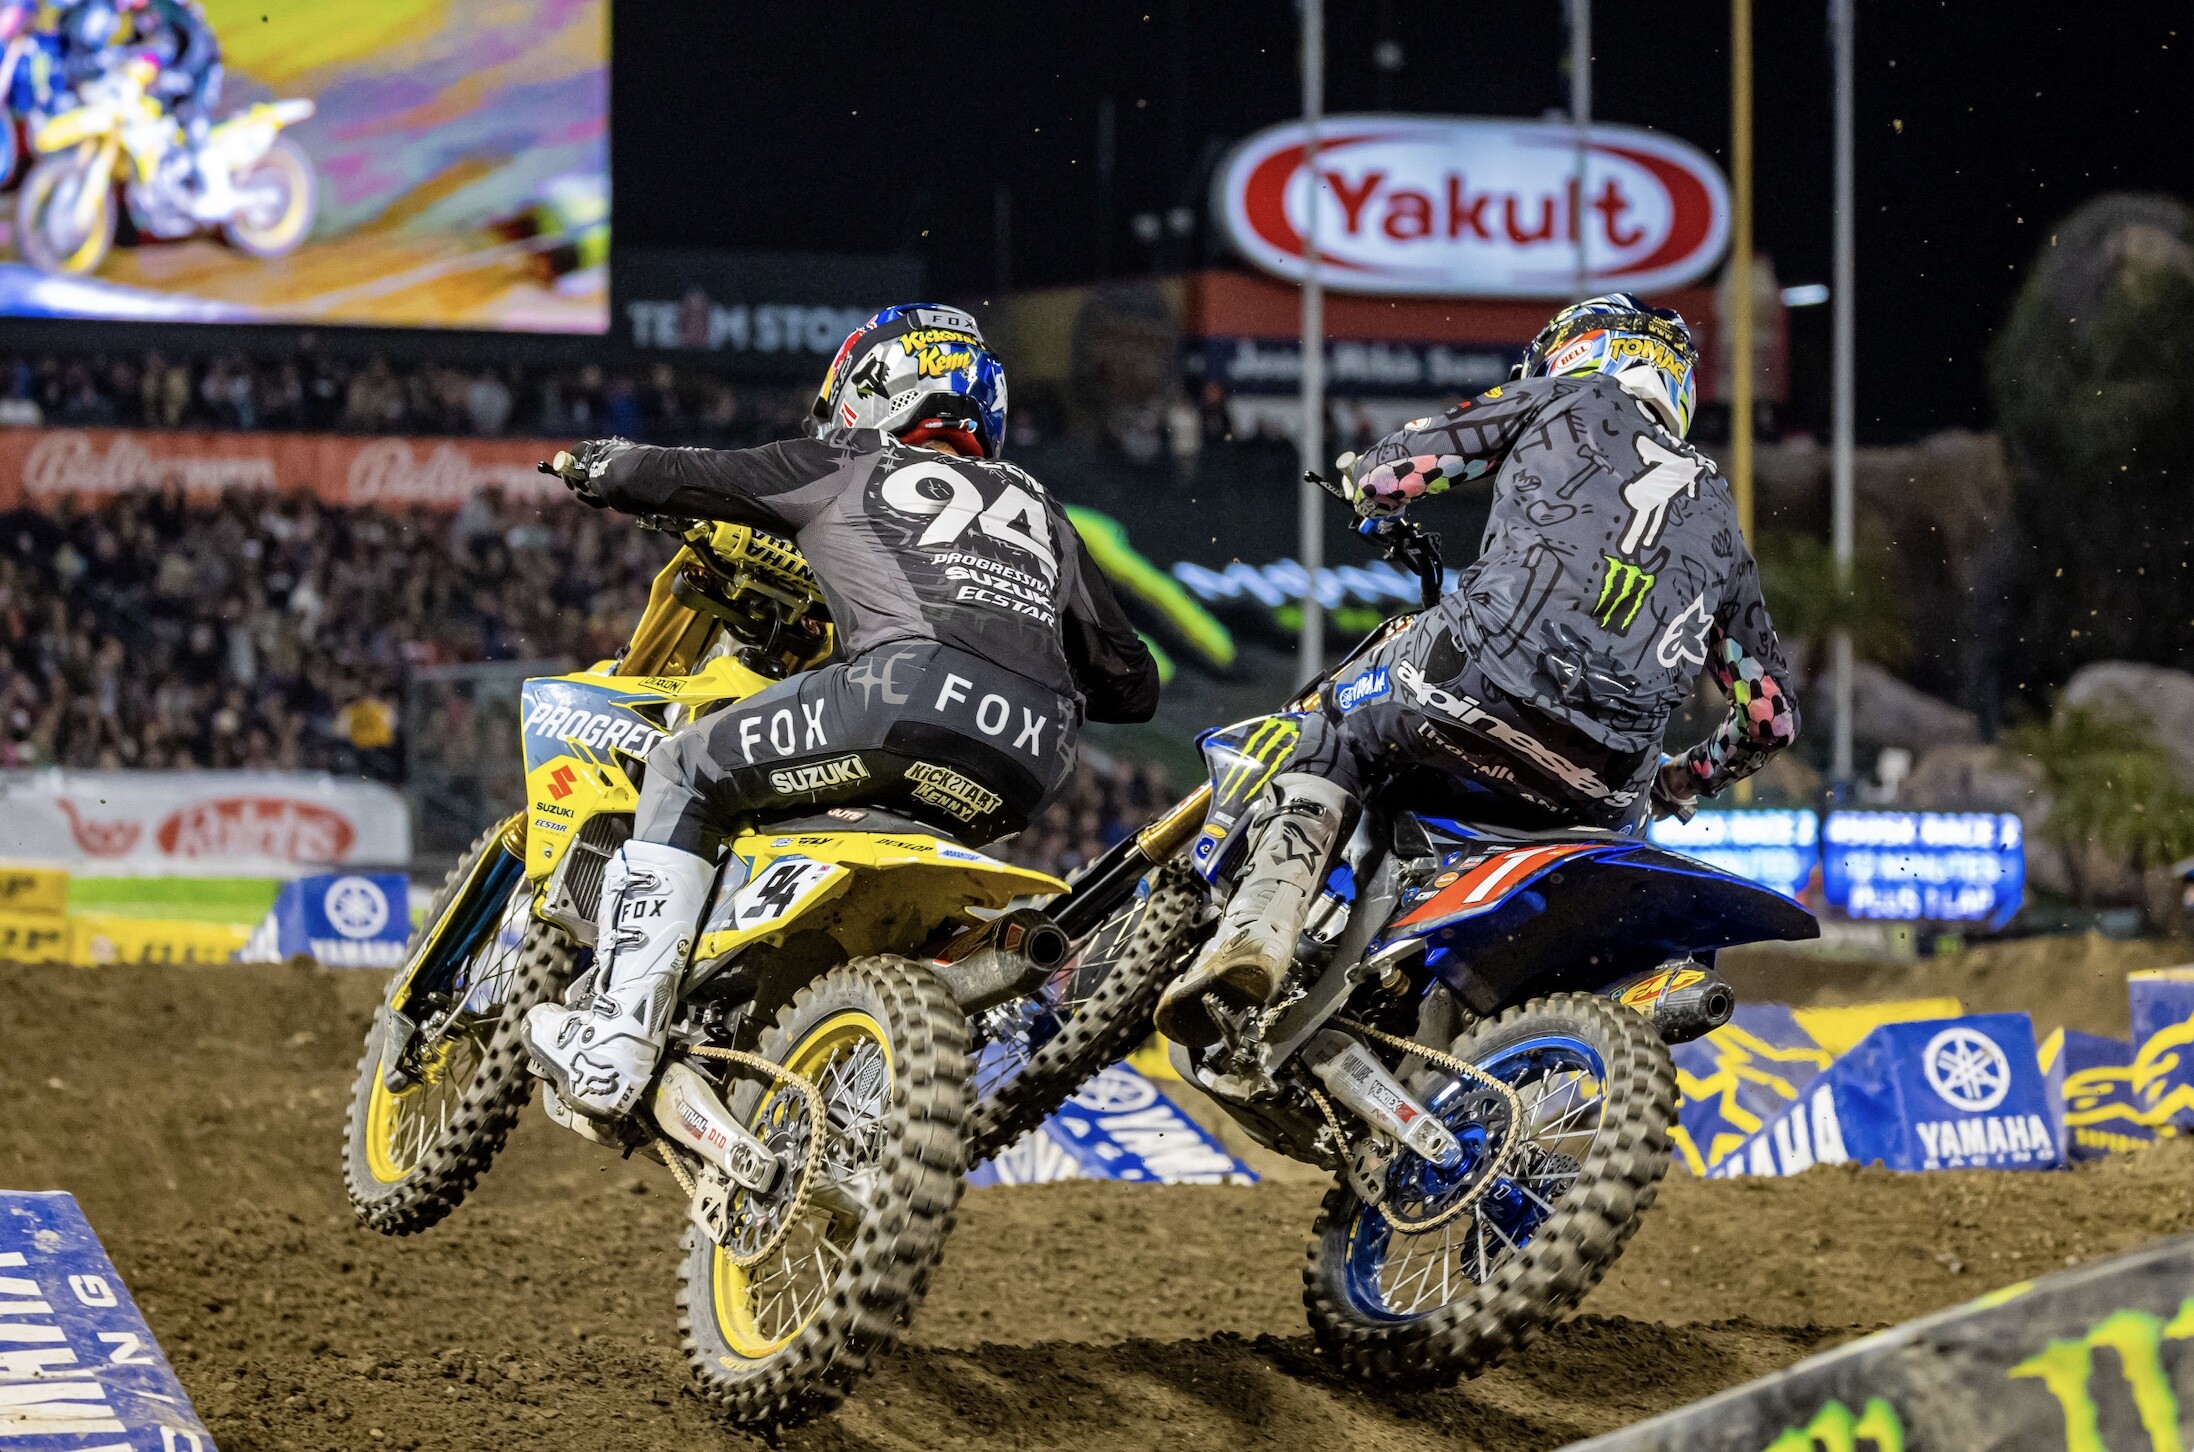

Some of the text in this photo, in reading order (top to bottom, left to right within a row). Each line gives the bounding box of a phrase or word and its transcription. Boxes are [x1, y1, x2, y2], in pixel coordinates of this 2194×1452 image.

[1321, 169, 1647, 248] Yakult
[932, 315, 976, 329] FOX
[1561, 346, 1588, 366] BELL
[1609, 337, 1687, 386] TOMAC
[881, 460, 1059, 592] 94
[944, 565, 1056, 613] SUZUK
[956, 585, 1056, 629] ECSTAR
[523, 702, 684, 760] PROGRES
[739, 698, 828, 765] FOX
[935, 672, 1048, 757] FOX
[771, 756, 869, 794] SUZUKI
[536, 802, 574, 819] SUZUKI
[916, 783, 974, 819] KENNY
[534, 819, 568, 833] ECSTAR
[875, 838, 934, 852] DUNLOP
[741, 864, 812, 919] 94
[1463, 846, 1558, 904] 1
[622, 900, 667, 923] FOX
[1340, 1052, 1375, 1085] YAMALUBE
[616, 1084, 635, 1109] FOX
[1367, 1079, 1405, 1113] VORTEX
[676, 1101, 708, 1134] ENTHAL
[707, 1127, 727, 1150] DID
[1916, 1114, 2052, 1160] YAMAHA
